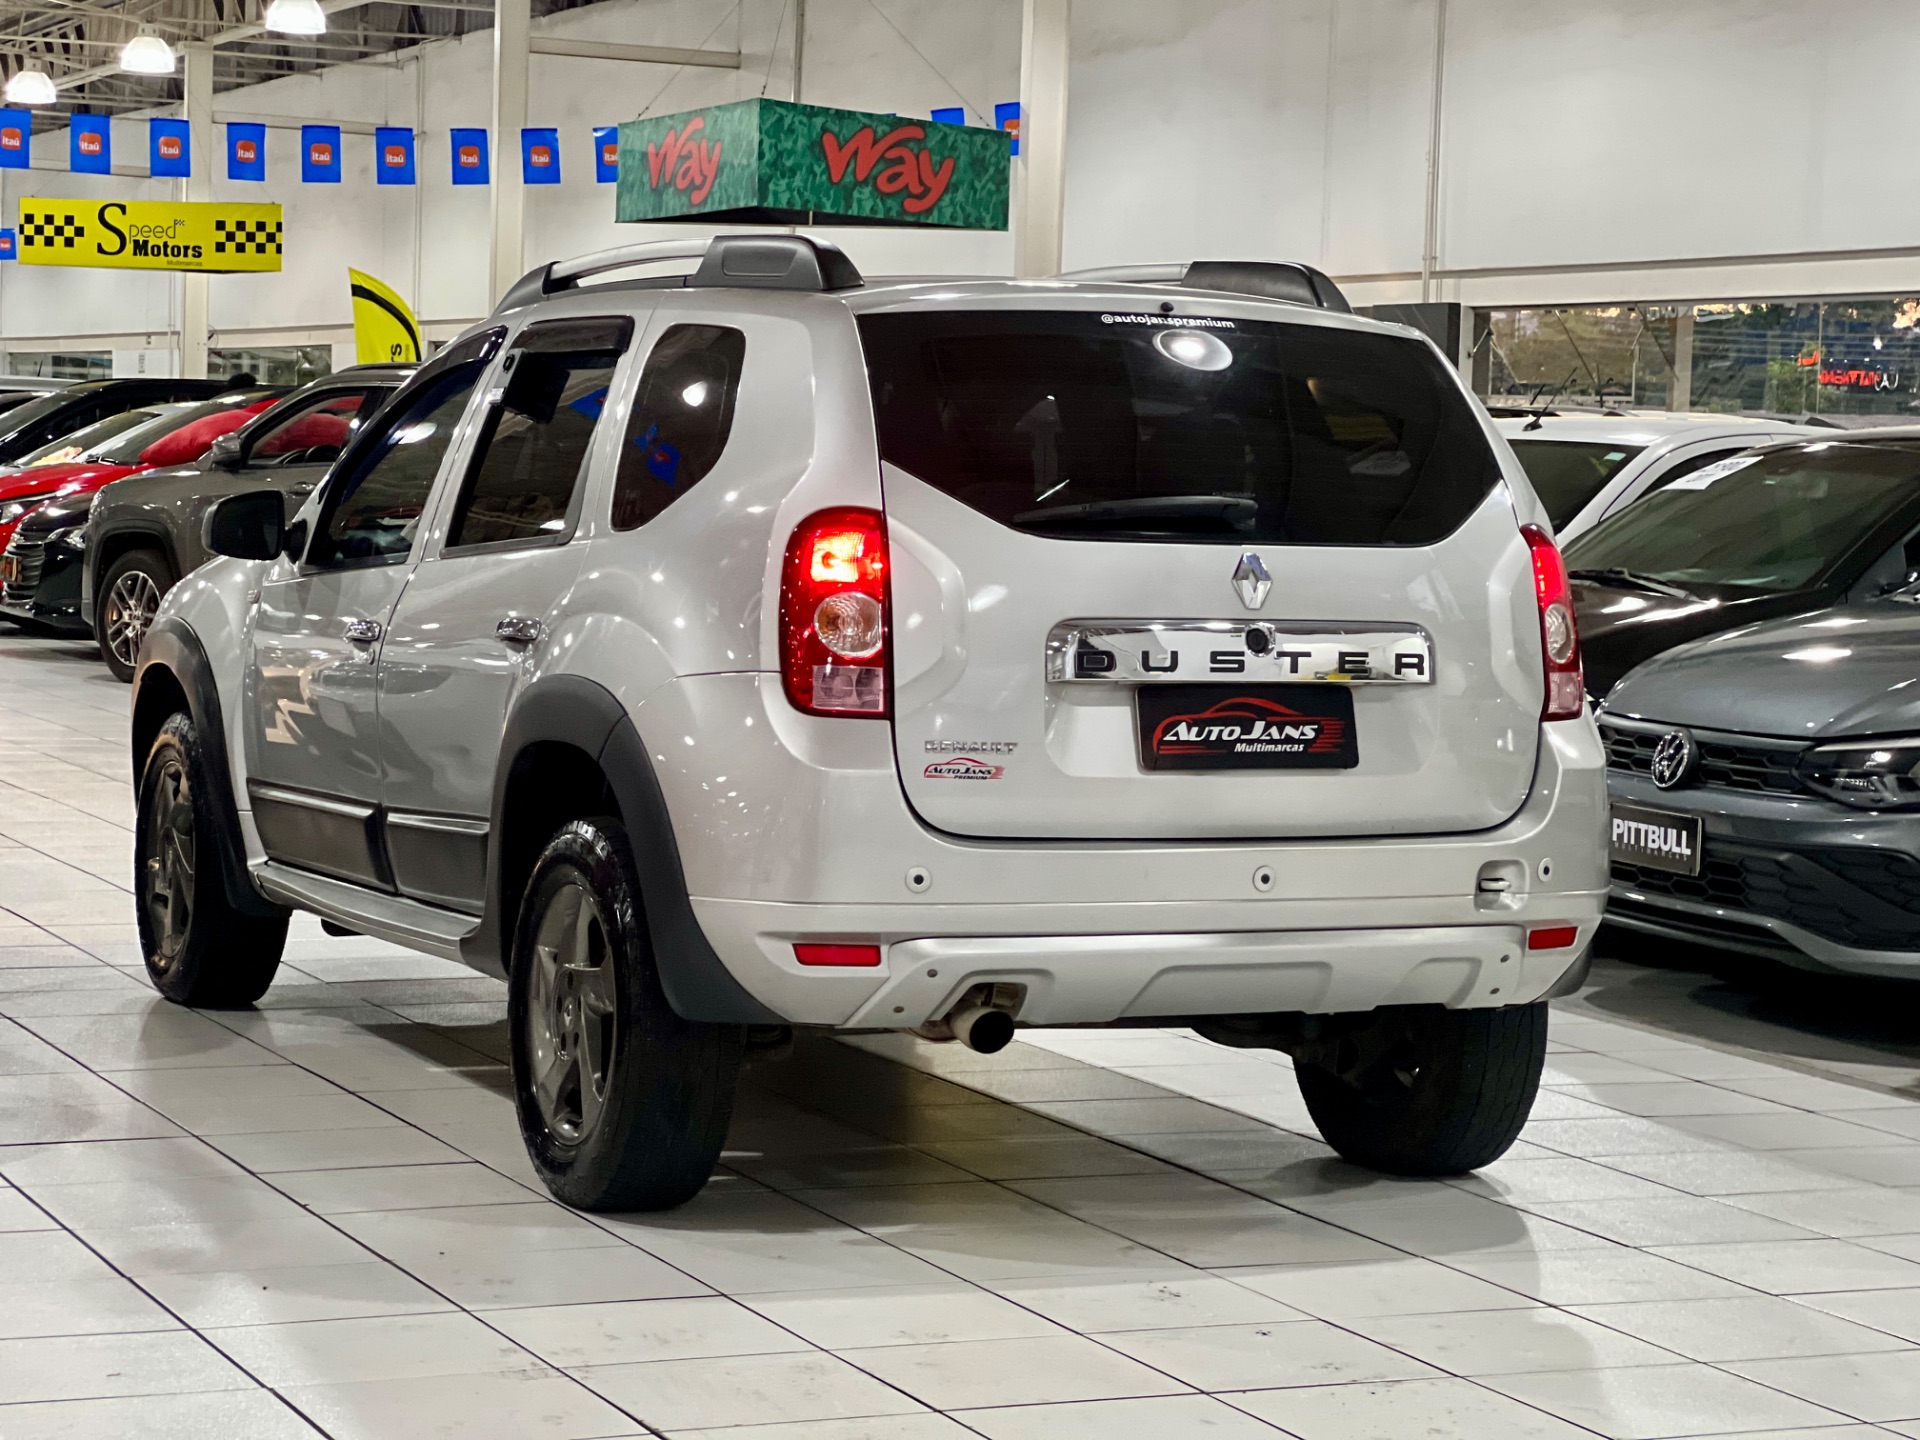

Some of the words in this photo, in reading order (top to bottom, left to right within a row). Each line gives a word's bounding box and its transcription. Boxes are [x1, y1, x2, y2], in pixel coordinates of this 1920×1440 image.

[648, 117, 722, 205] Way
[822, 125, 955, 213] Way
[97, 203, 176, 256] Speed
[132, 239, 202, 258] Motors
[1076, 650, 1425, 677] DUSTER
[925, 740, 1018, 754] RENAULT
[1234, 742, 1305, 753] Multimarcas
[1612, 818, 1692, 855] PITTBULL
